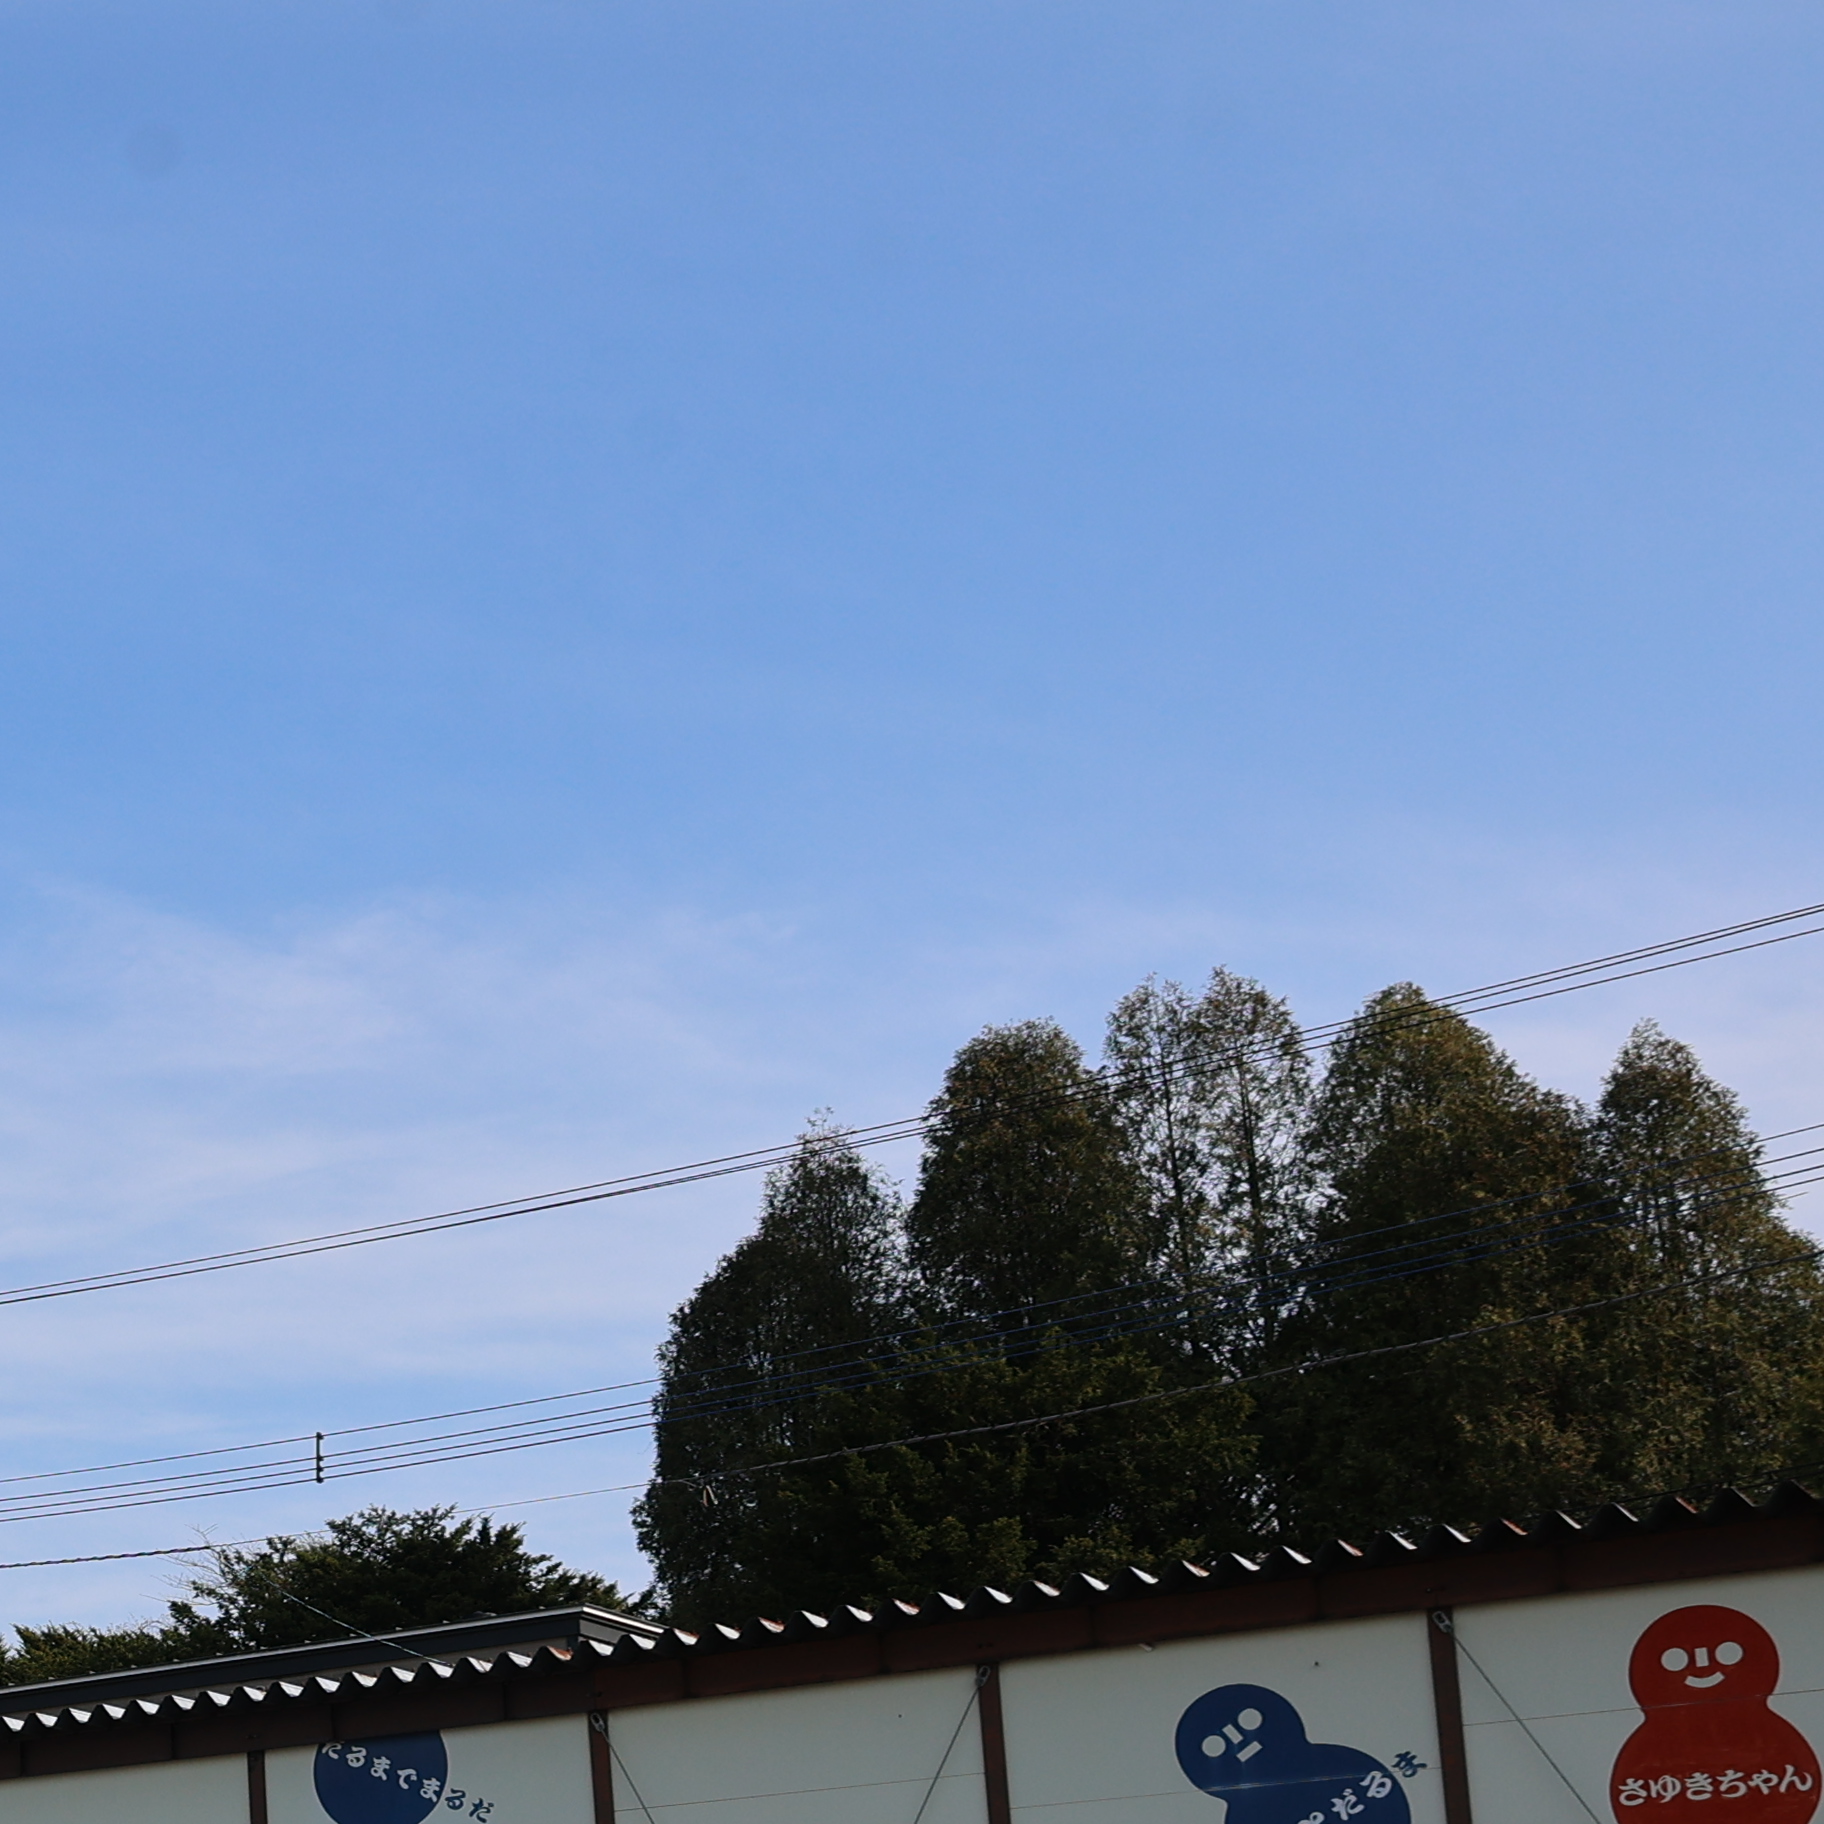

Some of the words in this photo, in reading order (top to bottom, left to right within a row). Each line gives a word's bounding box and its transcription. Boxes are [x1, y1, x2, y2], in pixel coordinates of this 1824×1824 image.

[1618, 1764, 1813, 1807] さゆきちゃん
